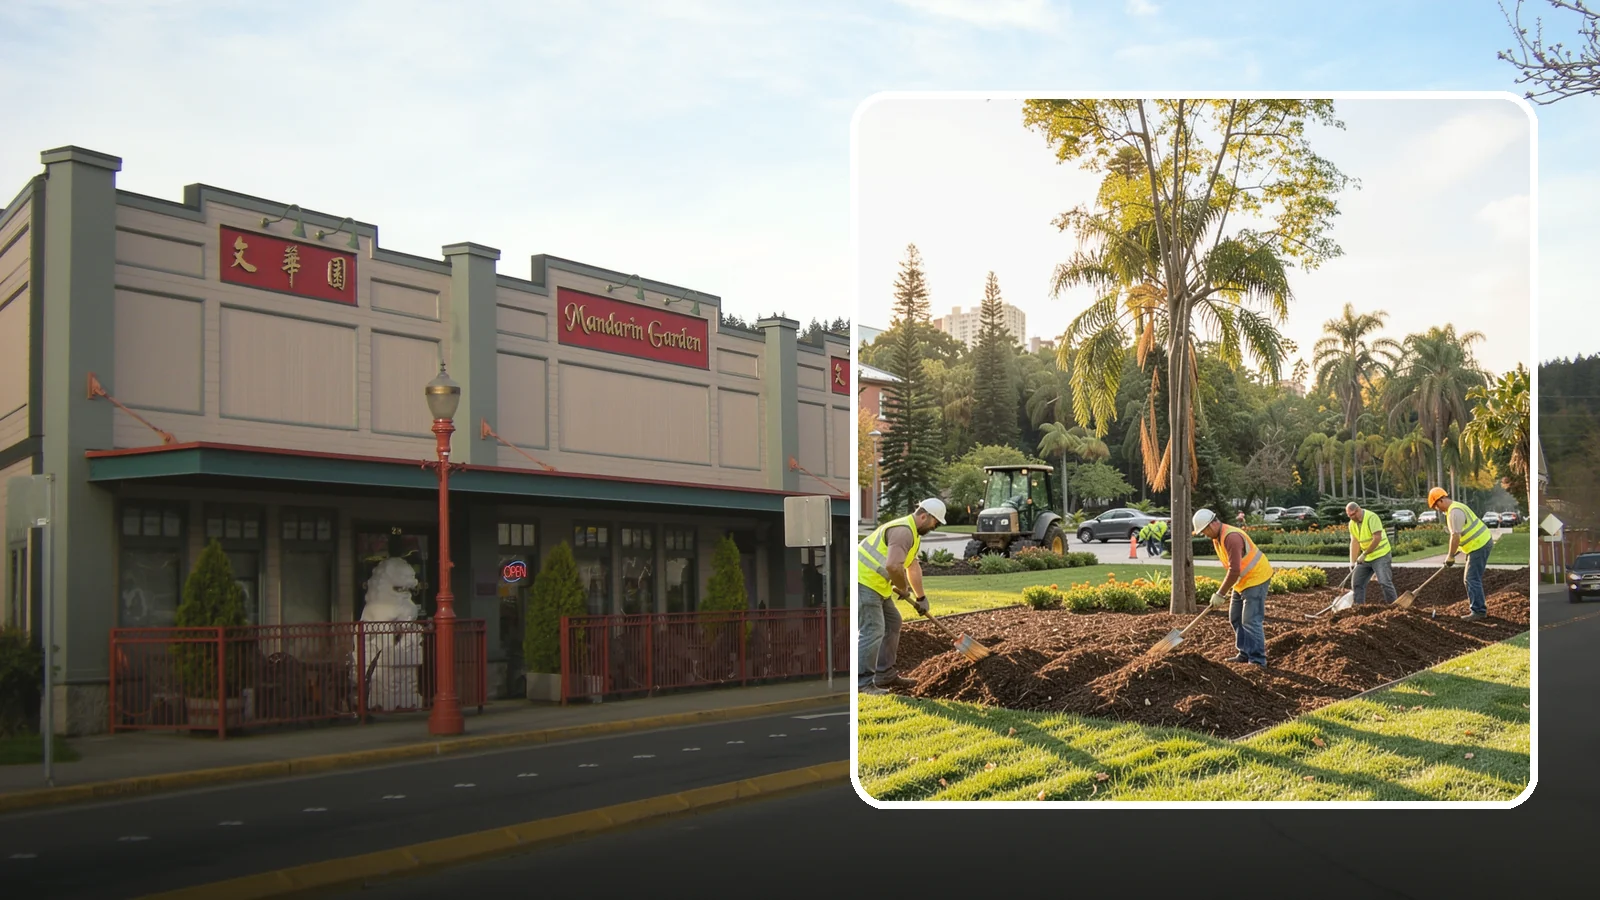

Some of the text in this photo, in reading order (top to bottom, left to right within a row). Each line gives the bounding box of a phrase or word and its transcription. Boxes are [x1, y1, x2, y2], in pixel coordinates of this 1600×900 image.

[230, 235, 346, 291] 文華園
[564, 302, 701, 352] Mandarin Garden
[503, 565, 527, 578] OPEN
